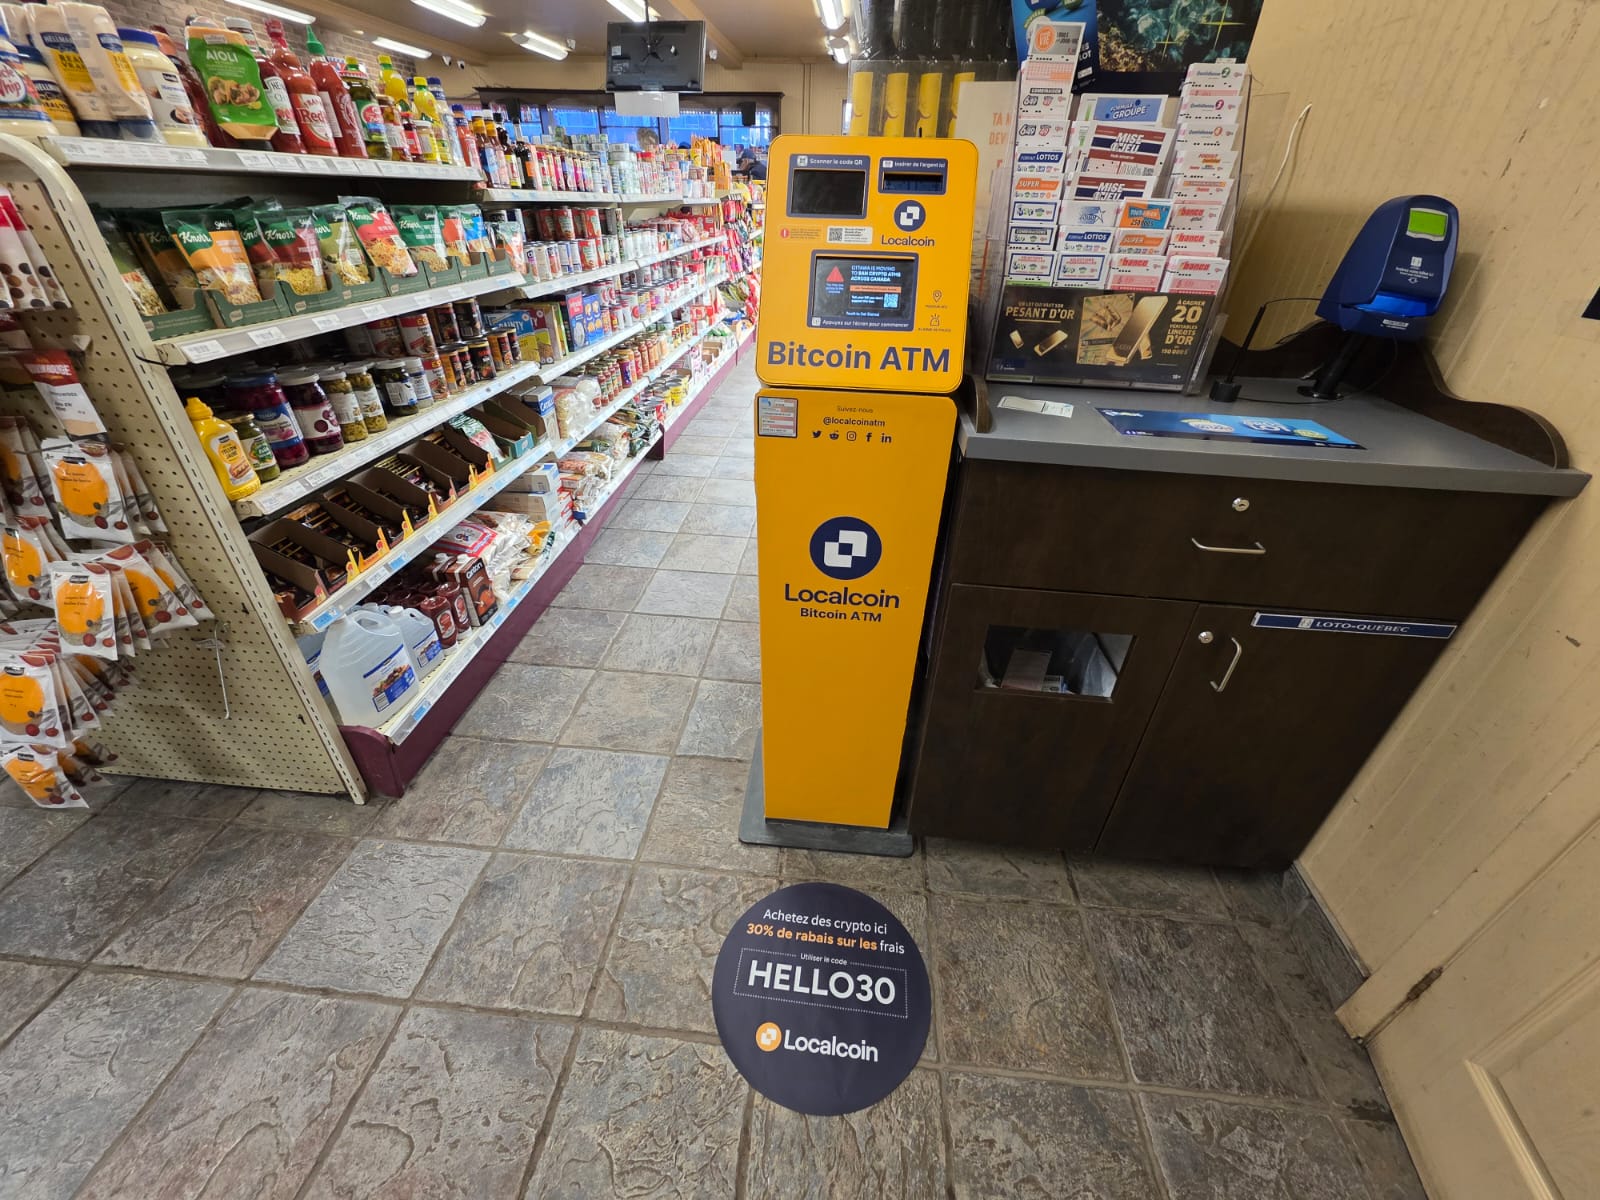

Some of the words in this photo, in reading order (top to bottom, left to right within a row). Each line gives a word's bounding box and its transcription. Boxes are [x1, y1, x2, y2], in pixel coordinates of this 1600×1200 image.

[206, 50, 238, 63] AIOLI
[1112, 106, 1146, 119] GROUPE
[1116, 132, 1144, 143] MISE
[1098, 182, 1125, 193] MISE
[347, 209, 374, 221] Knorr
[1179, 207, 1204, 216] banco
[178, 231, 212, 243] Knorr
[264, 229, 295, 240] Knorr
[1178, 233, 1204, 242] banco
[881, 235, 935, 247] Localcoin
[1122, 257, 1148, 267] banco
[1183, 262, 1210, 270] banco
[1005, 306, 1047, 319] PESANT
[1049, 308, 1075, 319] D'OR
[1171, 305, 1203, 323] 20
[1165, 335, 1194, 345] D'OR
[768, 341, 871, 369] Bitcoin
[879, 346, 950, 373] ATM
[837, 405, 873, 413] Suivez-nous
[822, 416, 885, 427] @localcoinatm
[784, 583, 900, 608] Localcoin
[800, 607, 847, 620] Bitcoin
[850, 611, 882, 623] ATM
[763, 908, 808, 925] Achetez
[811, 914, 831, 928] des
[834, 918, 871, 934] crypto
[874, 921, 887, 934] ici
[746, 923, 774, 937] 30%
[776, 926, 792, 940] de
[795, 930, 834, 944] rabais
[836, 936, 856, 948] sur
[859, 937, 878, 951] les
[879, 939, 905, 954] frais
[800, 953, 823, 963] Utiliser
[824, 955, 830, 963] le
[830, 957, 847, 965] code
[748, 959, 896, 1005] HELLO30
[783, 1029, 879, 1063] Localcoin
